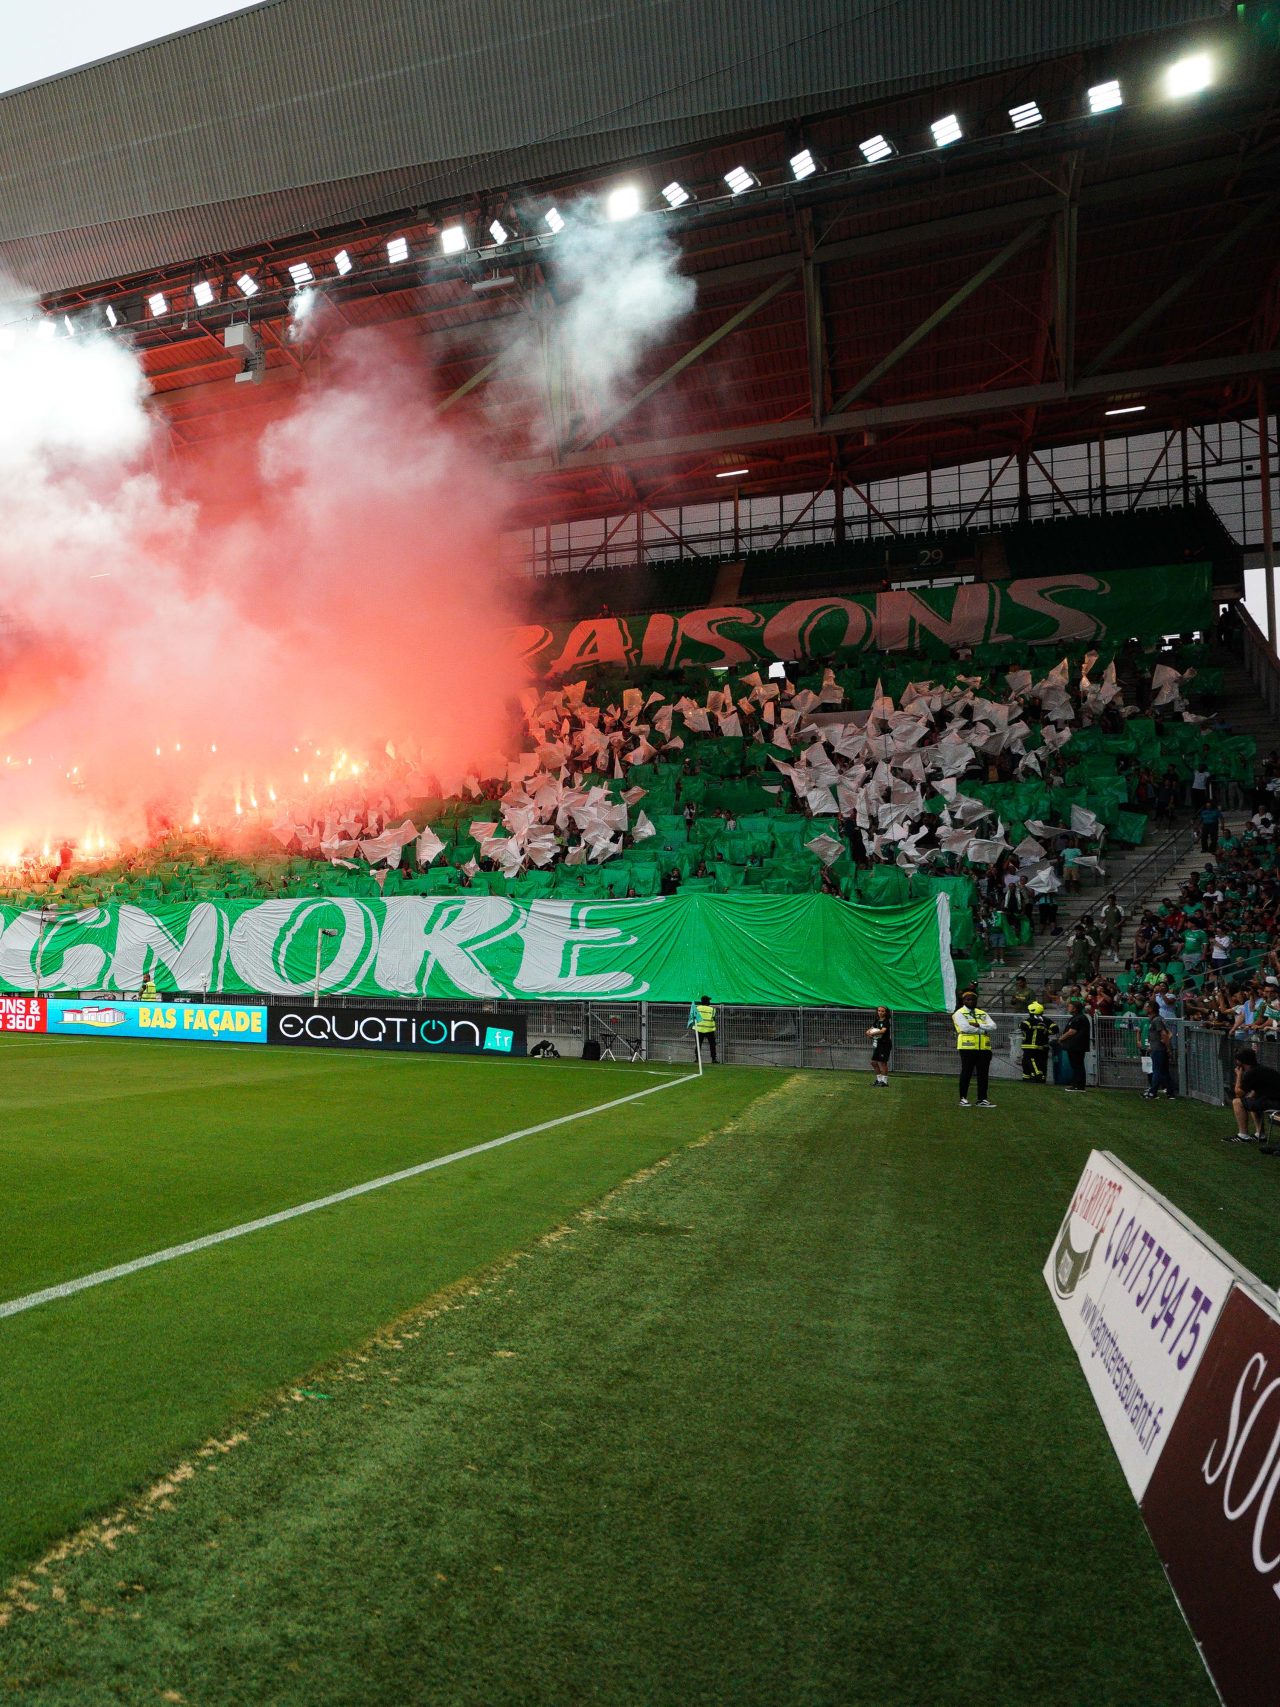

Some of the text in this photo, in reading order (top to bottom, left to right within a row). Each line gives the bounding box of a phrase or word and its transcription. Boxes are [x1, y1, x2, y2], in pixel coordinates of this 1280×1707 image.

[920, 549, 943, 566] 29
[29, 999, 41, 1015] &
[6, 1014, 41, 1031] 360°
[138, 1007, 263, 1037] BAS FAÇADE
[1112, 1216, 1213, 1371] 04 77 37 94 75
